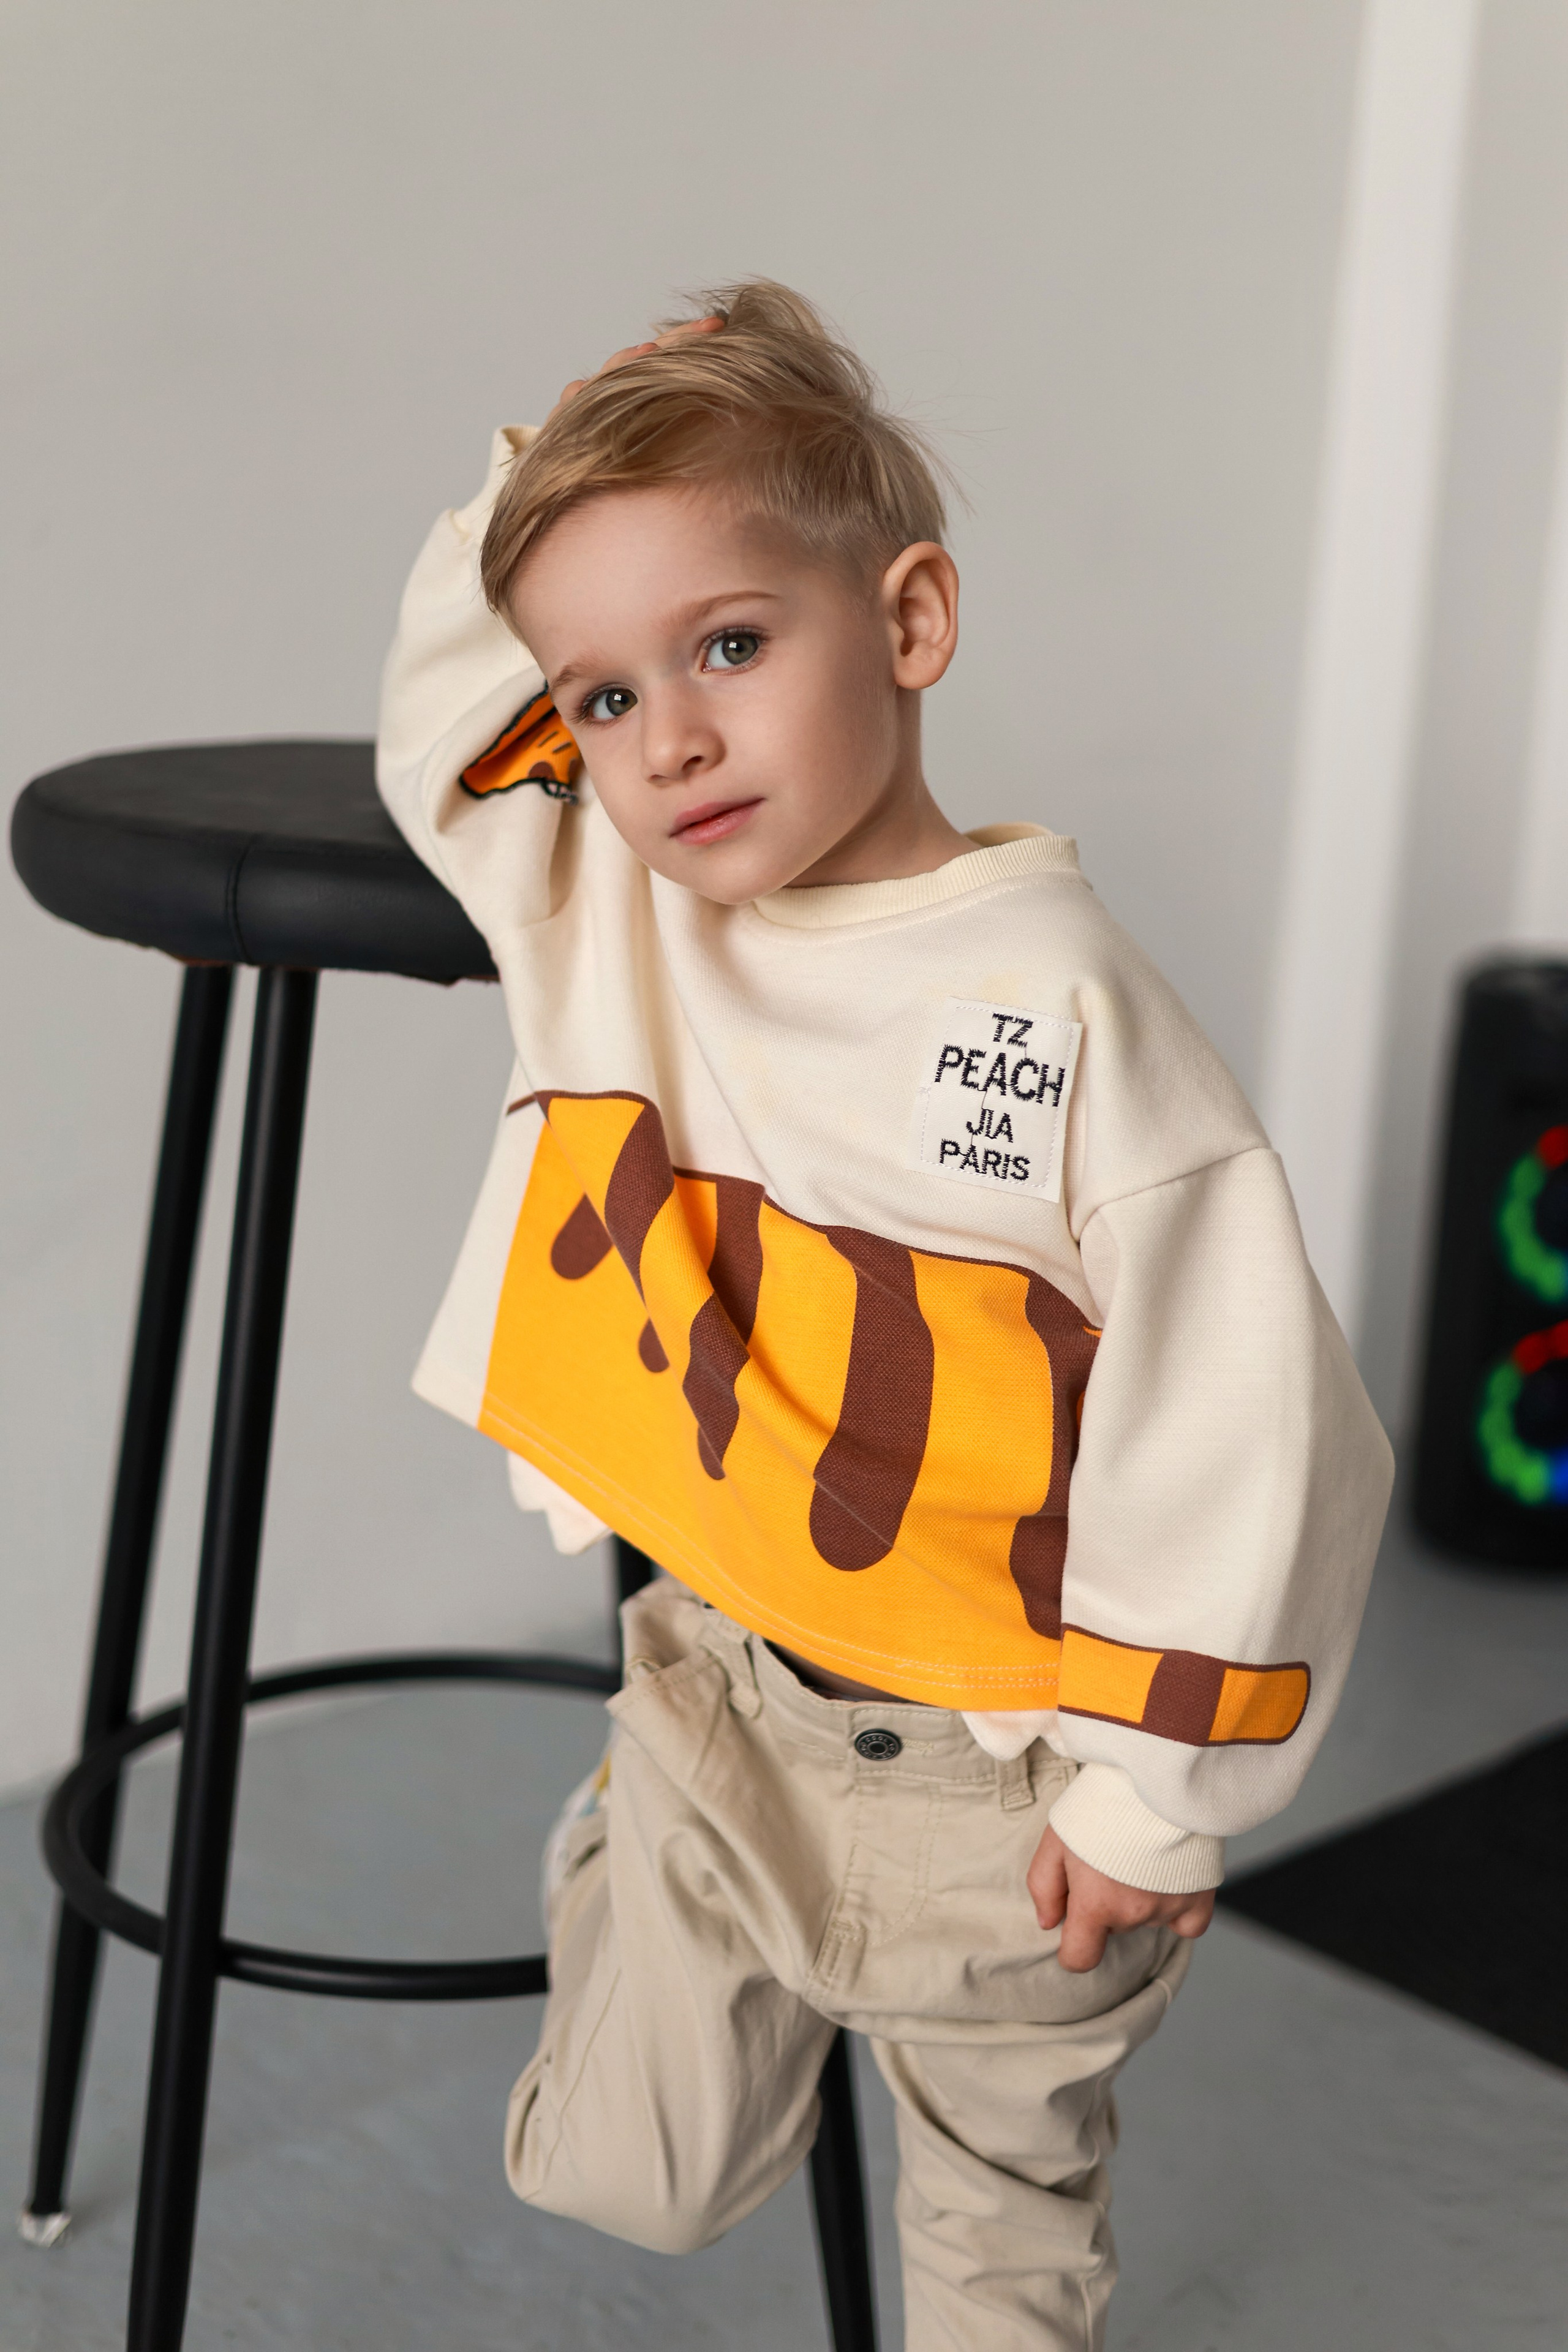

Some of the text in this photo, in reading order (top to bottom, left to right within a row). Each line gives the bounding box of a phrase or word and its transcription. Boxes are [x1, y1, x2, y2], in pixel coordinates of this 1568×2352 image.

[992, 1012, 1034, 1047] TZ
[934, 1044, 1066, 1107] PEACH
[939, 1138, 1031, 1182] PARIS
